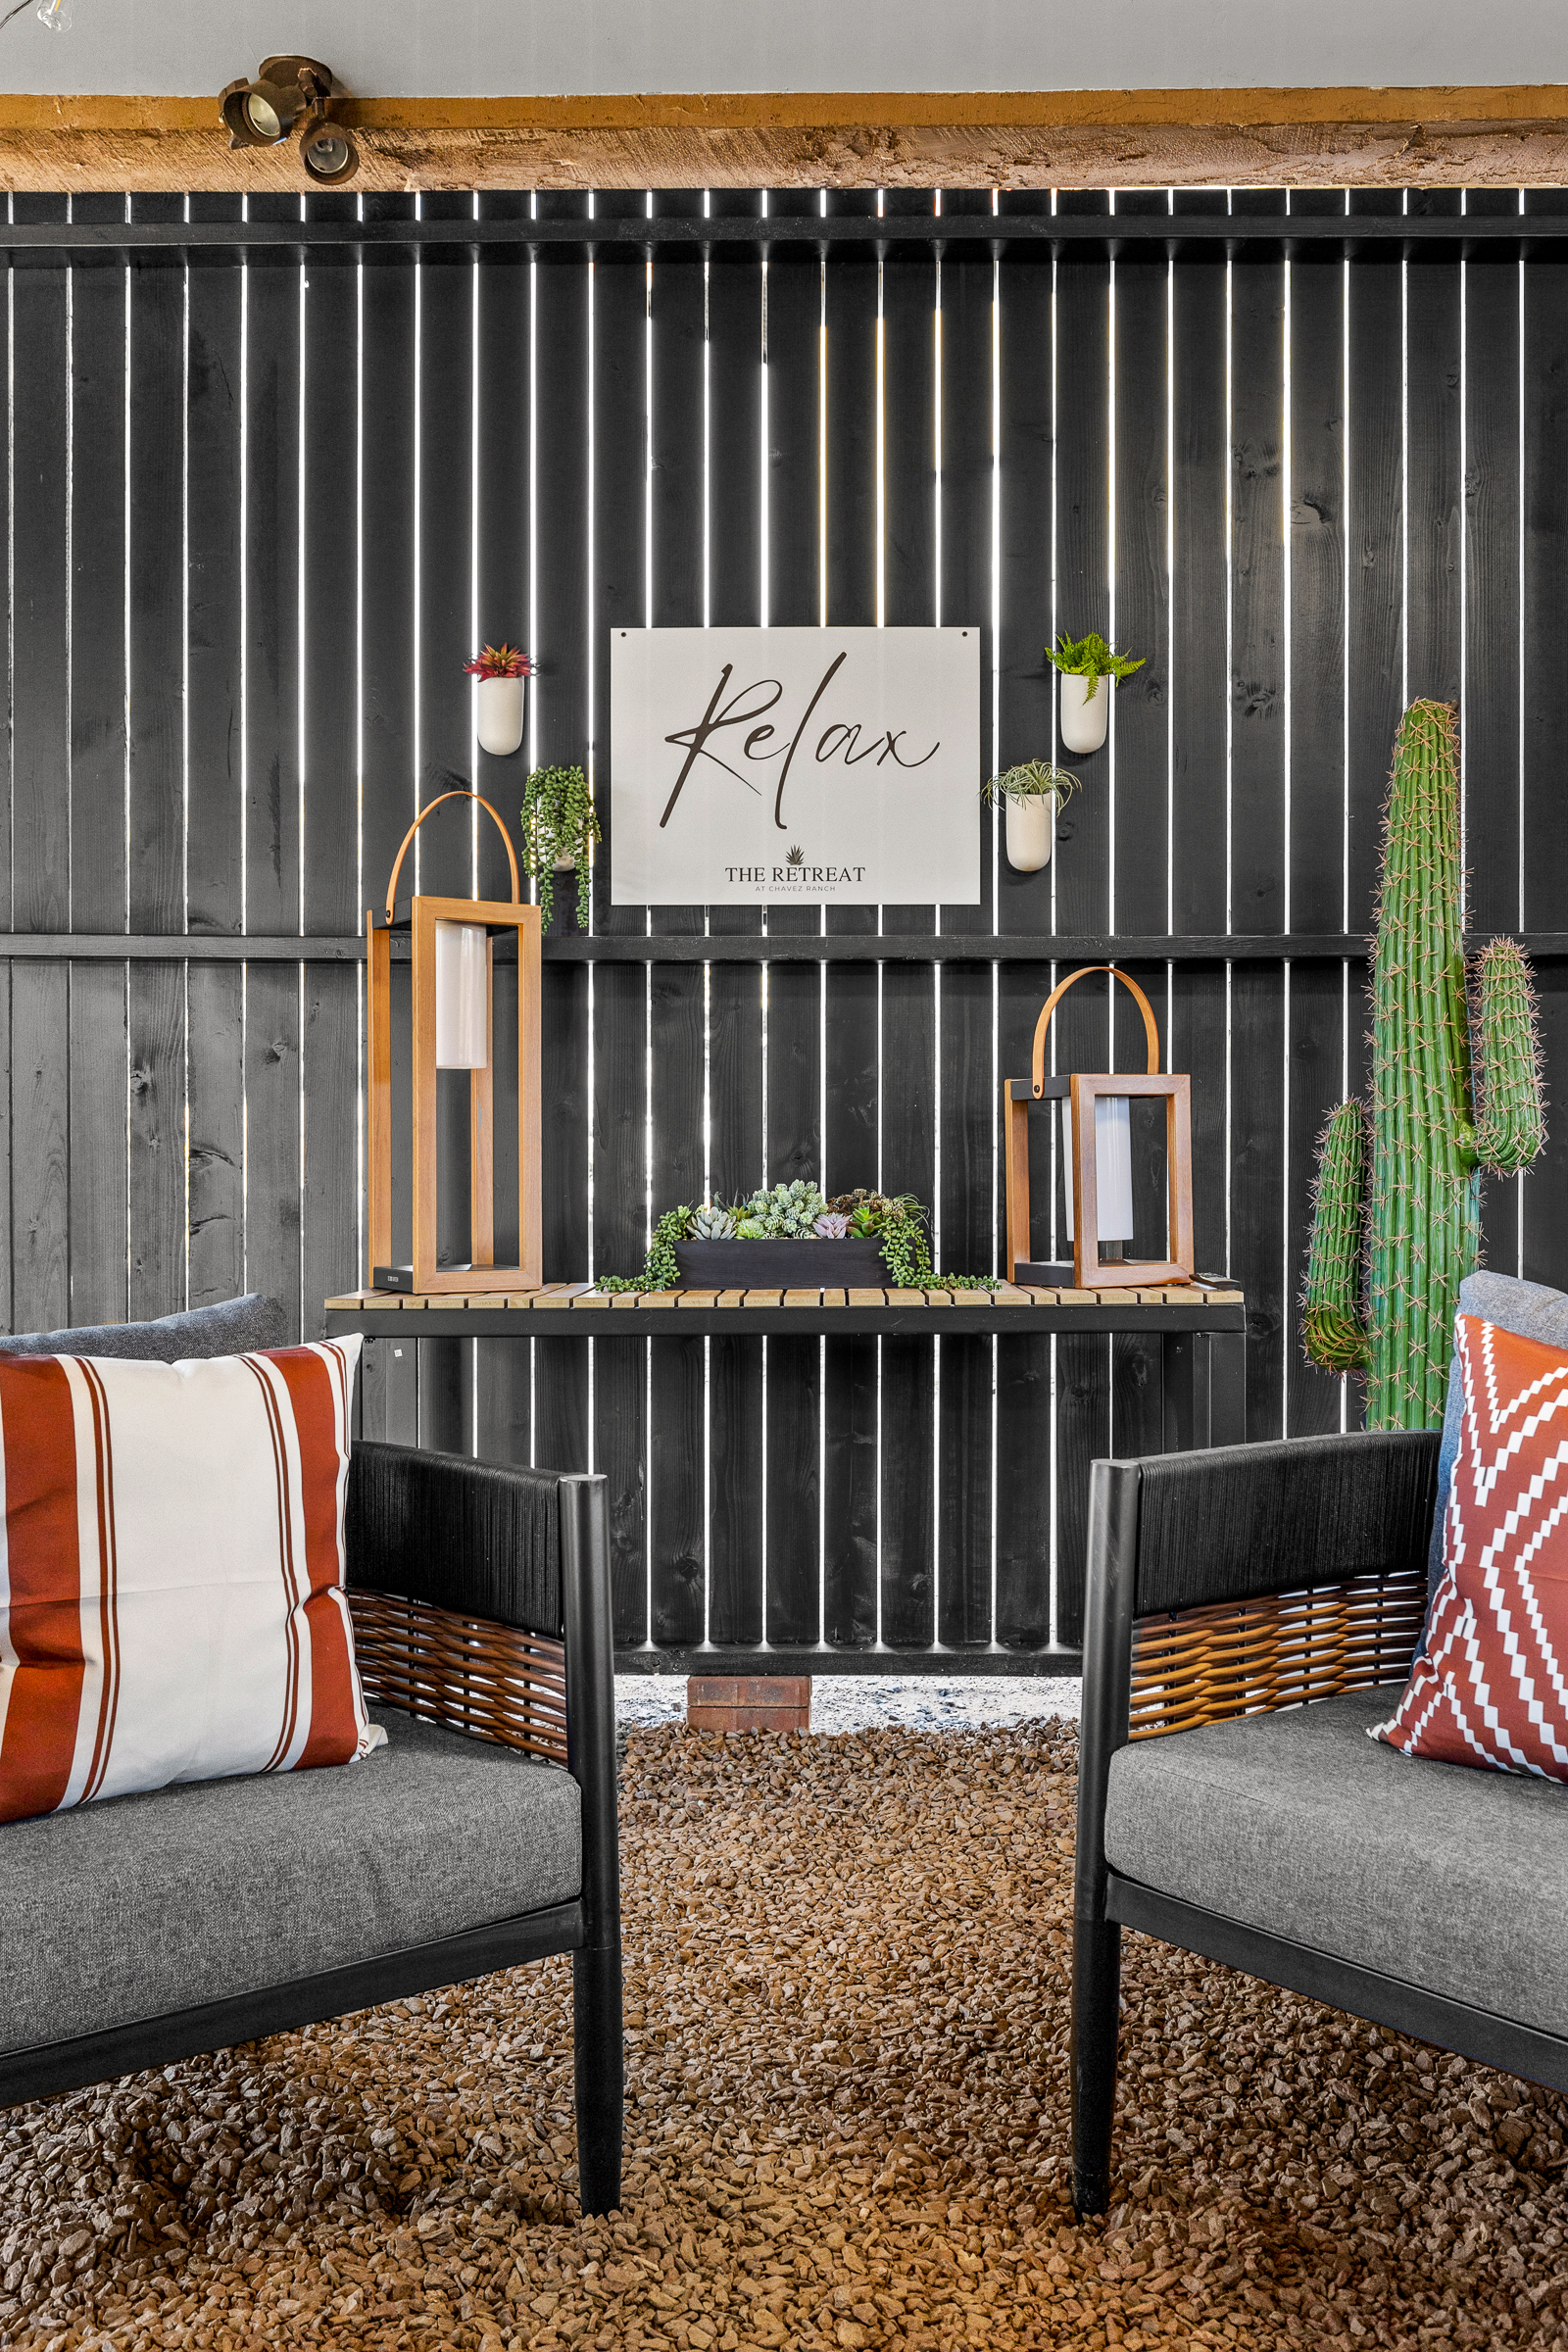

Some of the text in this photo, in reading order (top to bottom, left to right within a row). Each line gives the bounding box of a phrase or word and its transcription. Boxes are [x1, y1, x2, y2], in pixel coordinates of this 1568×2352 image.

[660, 652, 941, 830] Relax
[724, 867, 866, 882] THE RETREAT
